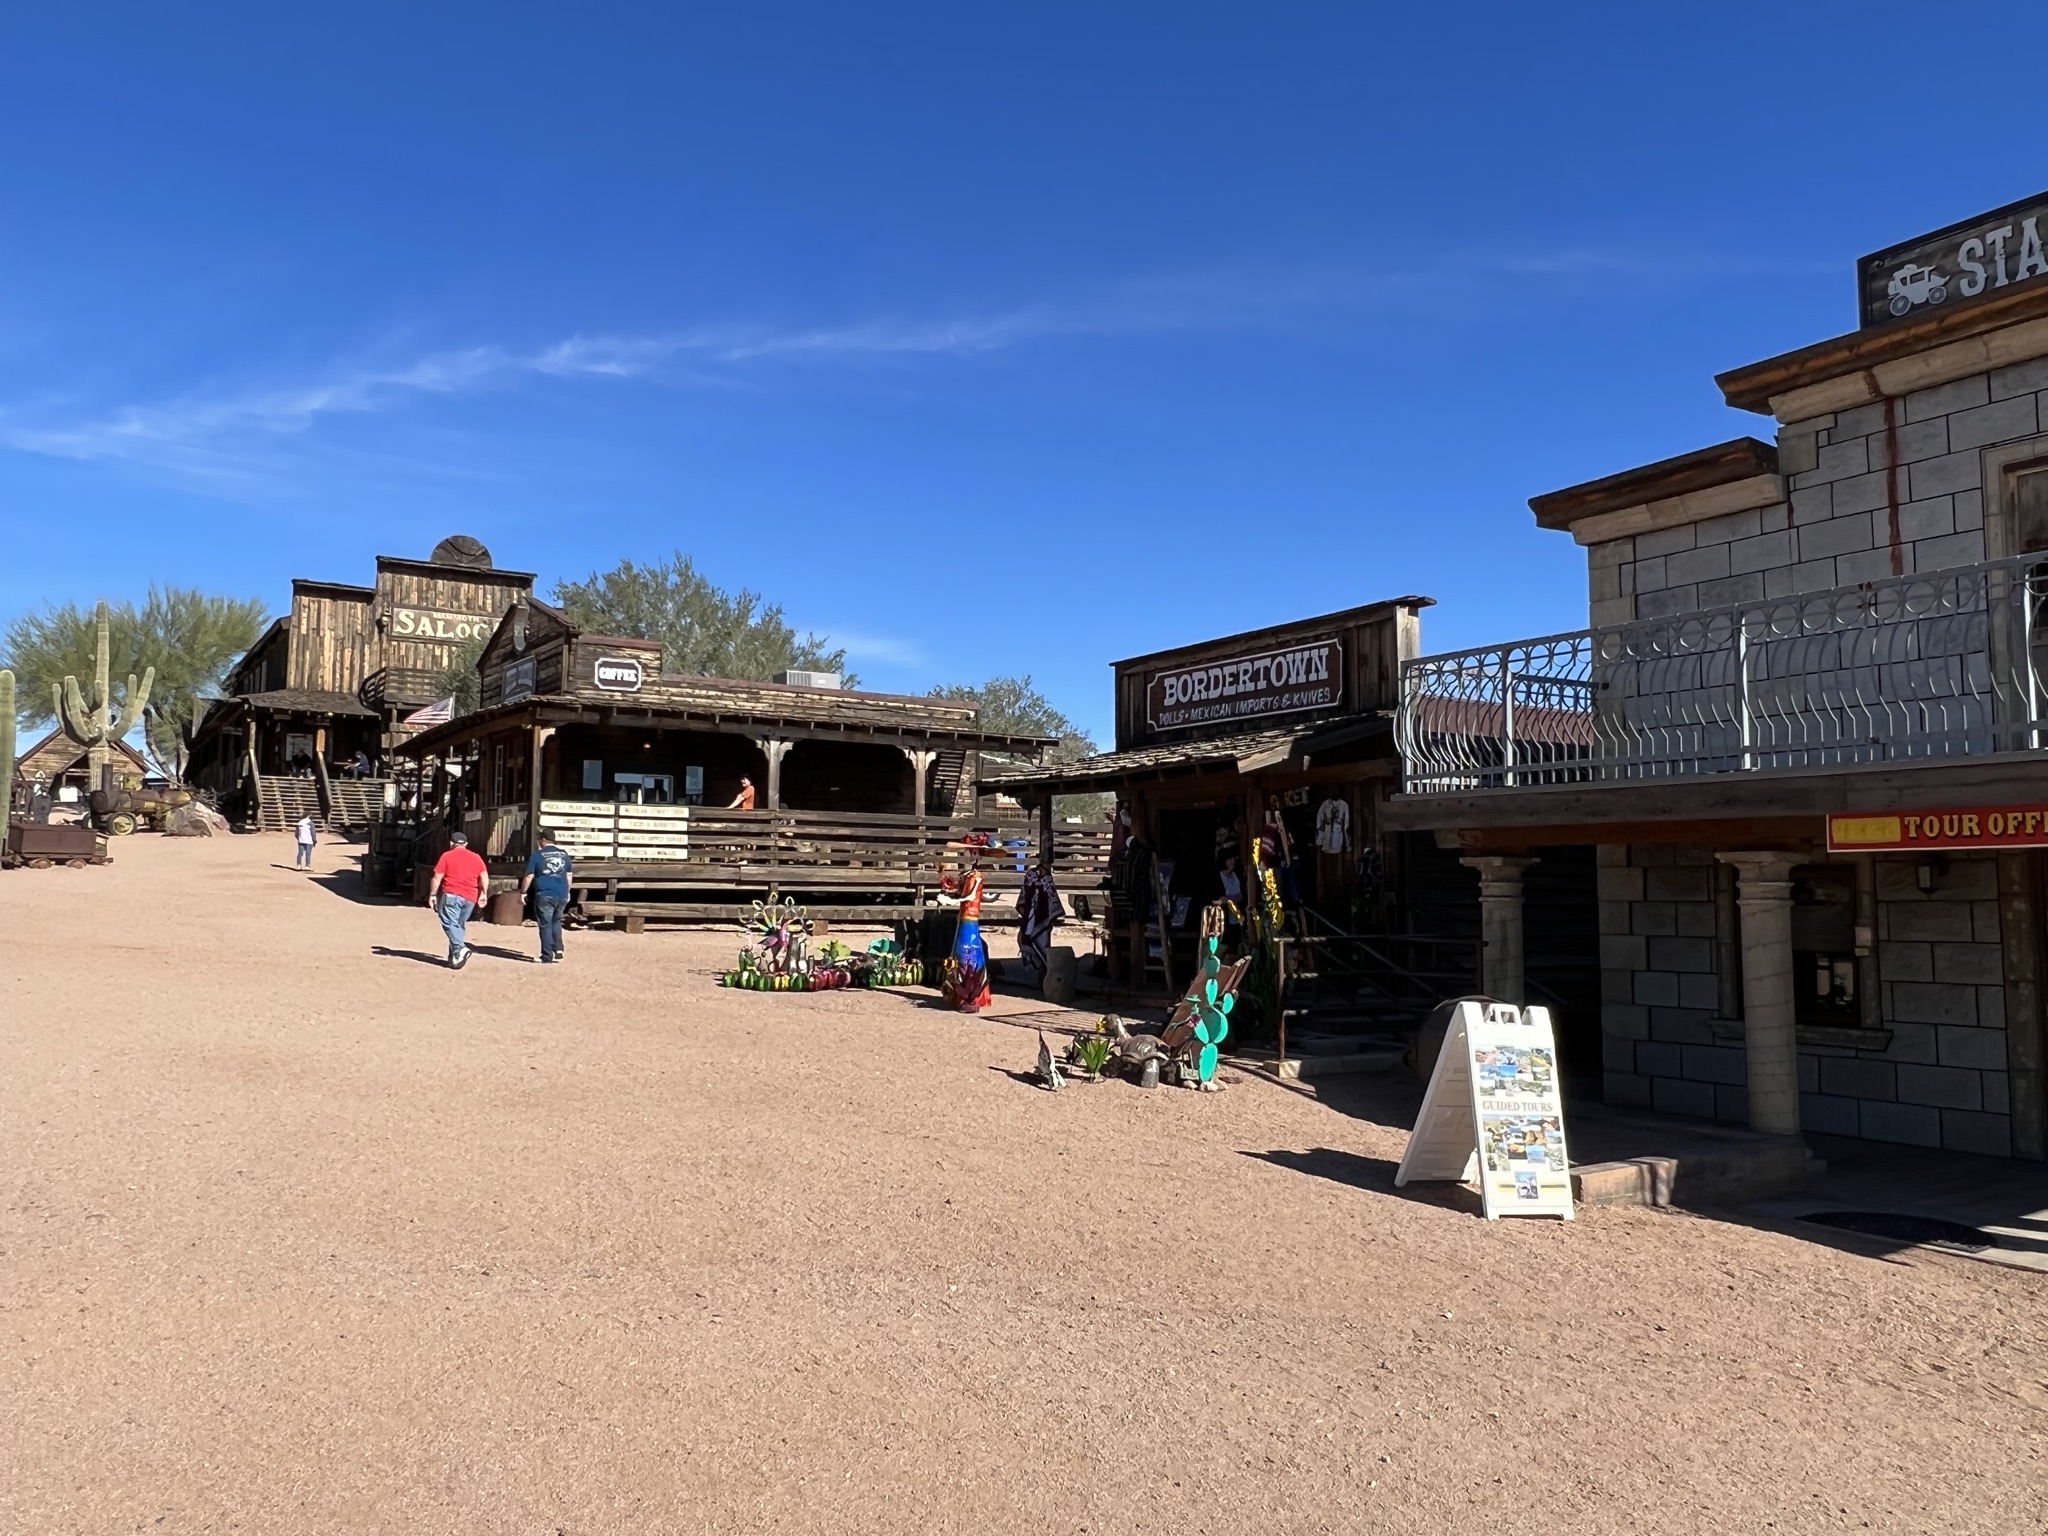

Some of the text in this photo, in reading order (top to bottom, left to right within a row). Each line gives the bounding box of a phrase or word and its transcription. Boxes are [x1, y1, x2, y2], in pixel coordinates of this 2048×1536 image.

[1958, 217, 2048, 297] STA
[600, 667, 638, 681] COFFEE
[1164, 647, 1328, 706] BORDERTOWN
[1159, 708, 1184, 726] DOLLS
[1189, 701, 1232, 721] MEXICAN
[1235, 695, 1279, 714] IMPORTS
[1293, 686, 1331, 706] KNIVES
[1904, 814, 1980, 838] TOUR
[1482, 1100, 1553, 1112] GUIDED TOURS
